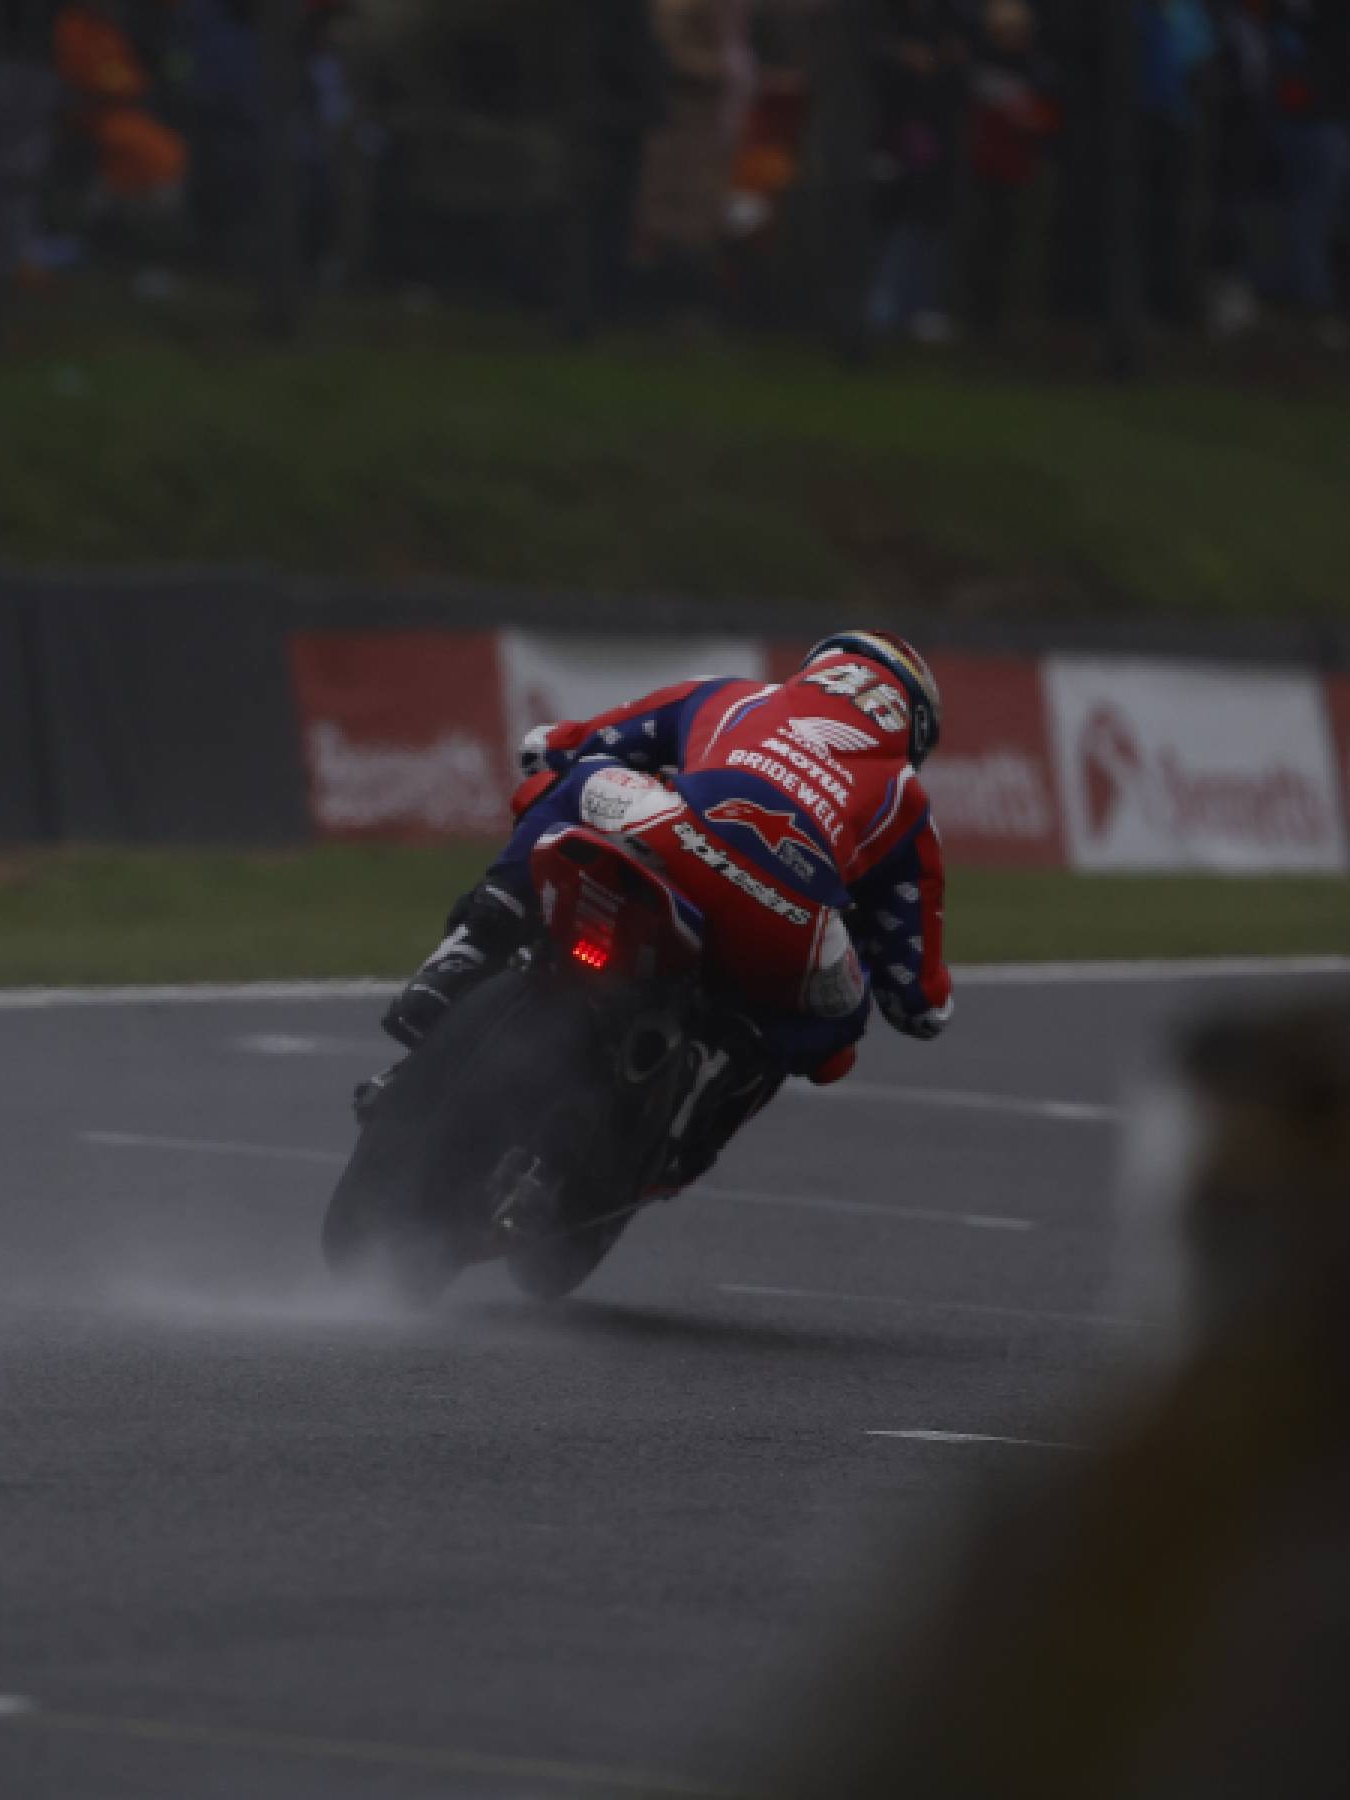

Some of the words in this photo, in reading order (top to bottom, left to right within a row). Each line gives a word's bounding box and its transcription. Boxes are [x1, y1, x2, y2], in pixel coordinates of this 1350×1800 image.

[803, 662, 906, 732] 46
[726, 749, 844, 847] BRIDEWELL
[672, 821, 812, 926] alpinestars
